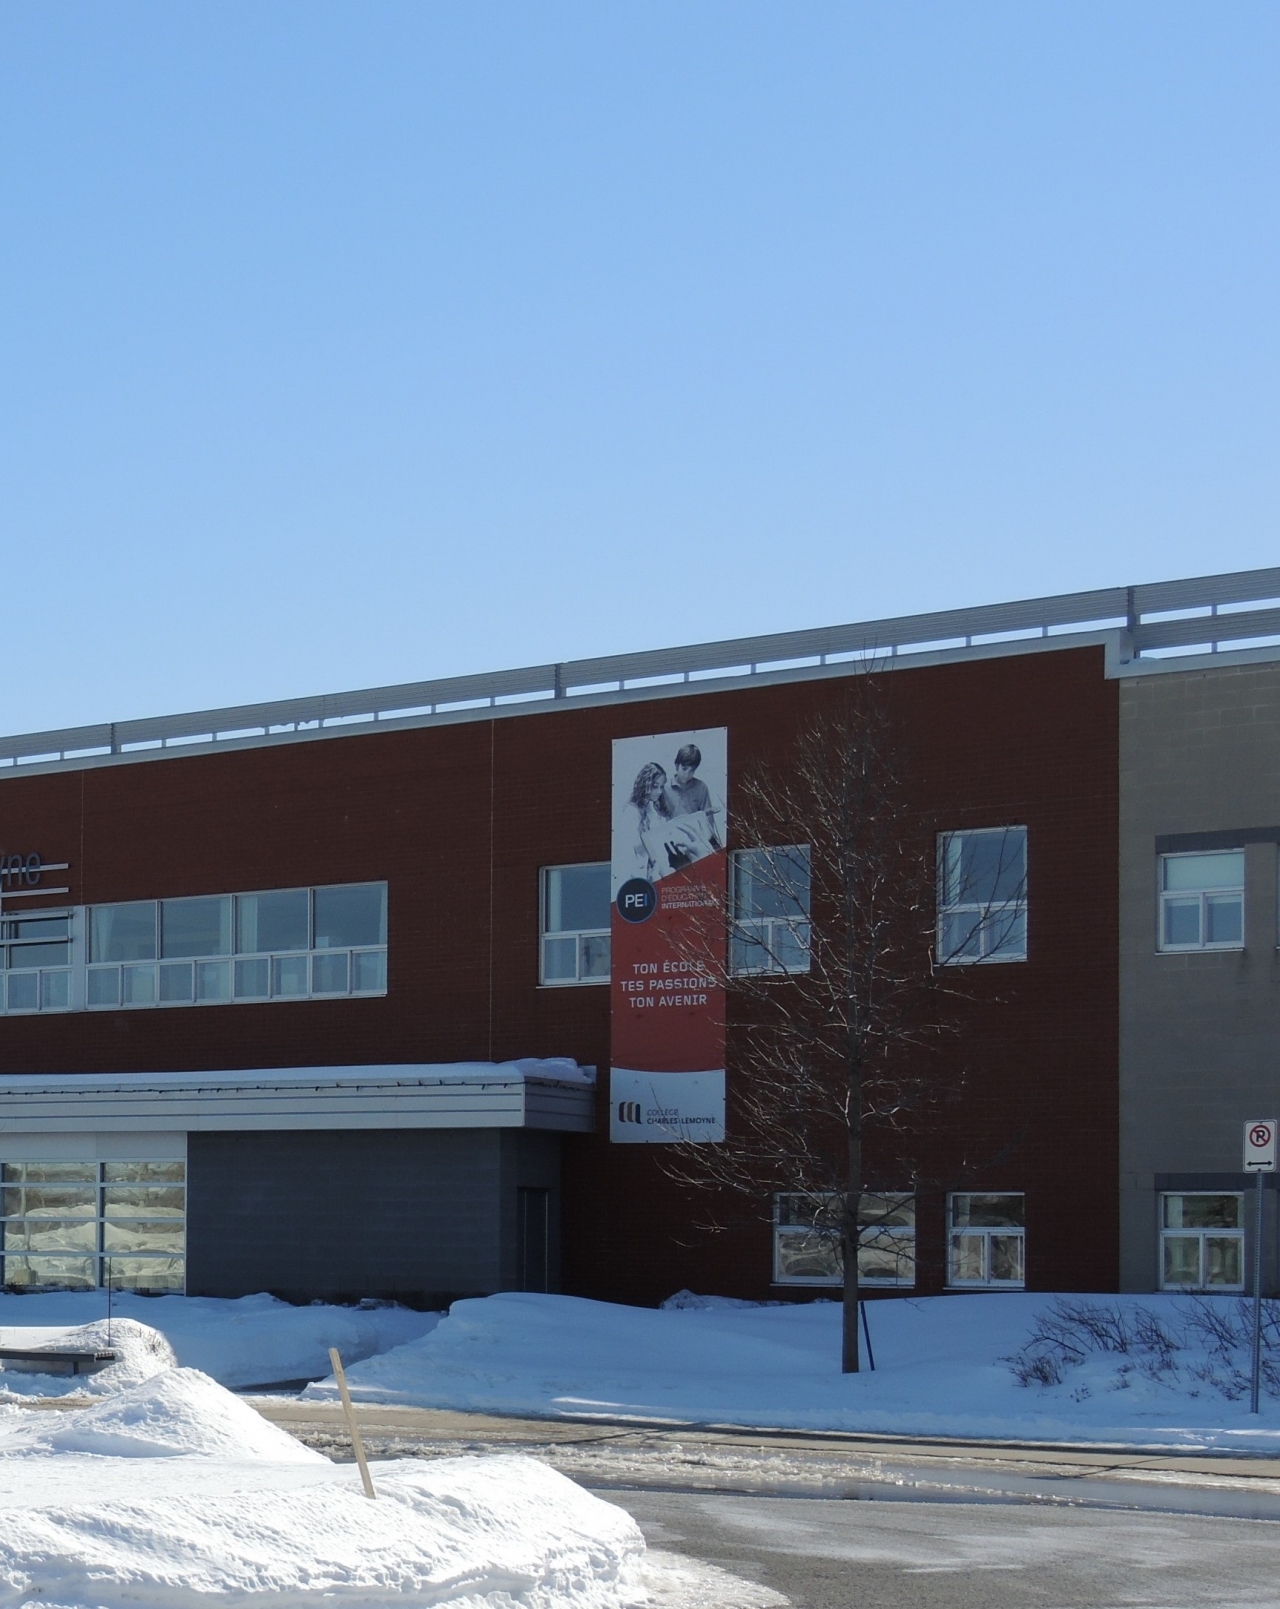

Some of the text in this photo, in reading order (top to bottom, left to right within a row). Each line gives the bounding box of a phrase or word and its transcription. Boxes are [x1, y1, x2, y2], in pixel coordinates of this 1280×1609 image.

[625, 894, 648, 908] PEI
[633, 963, 658, 975] TON
[621, 978, 717, 992] TES PASSIONS
[629, 994, 707, 1008] TON AVENIR
